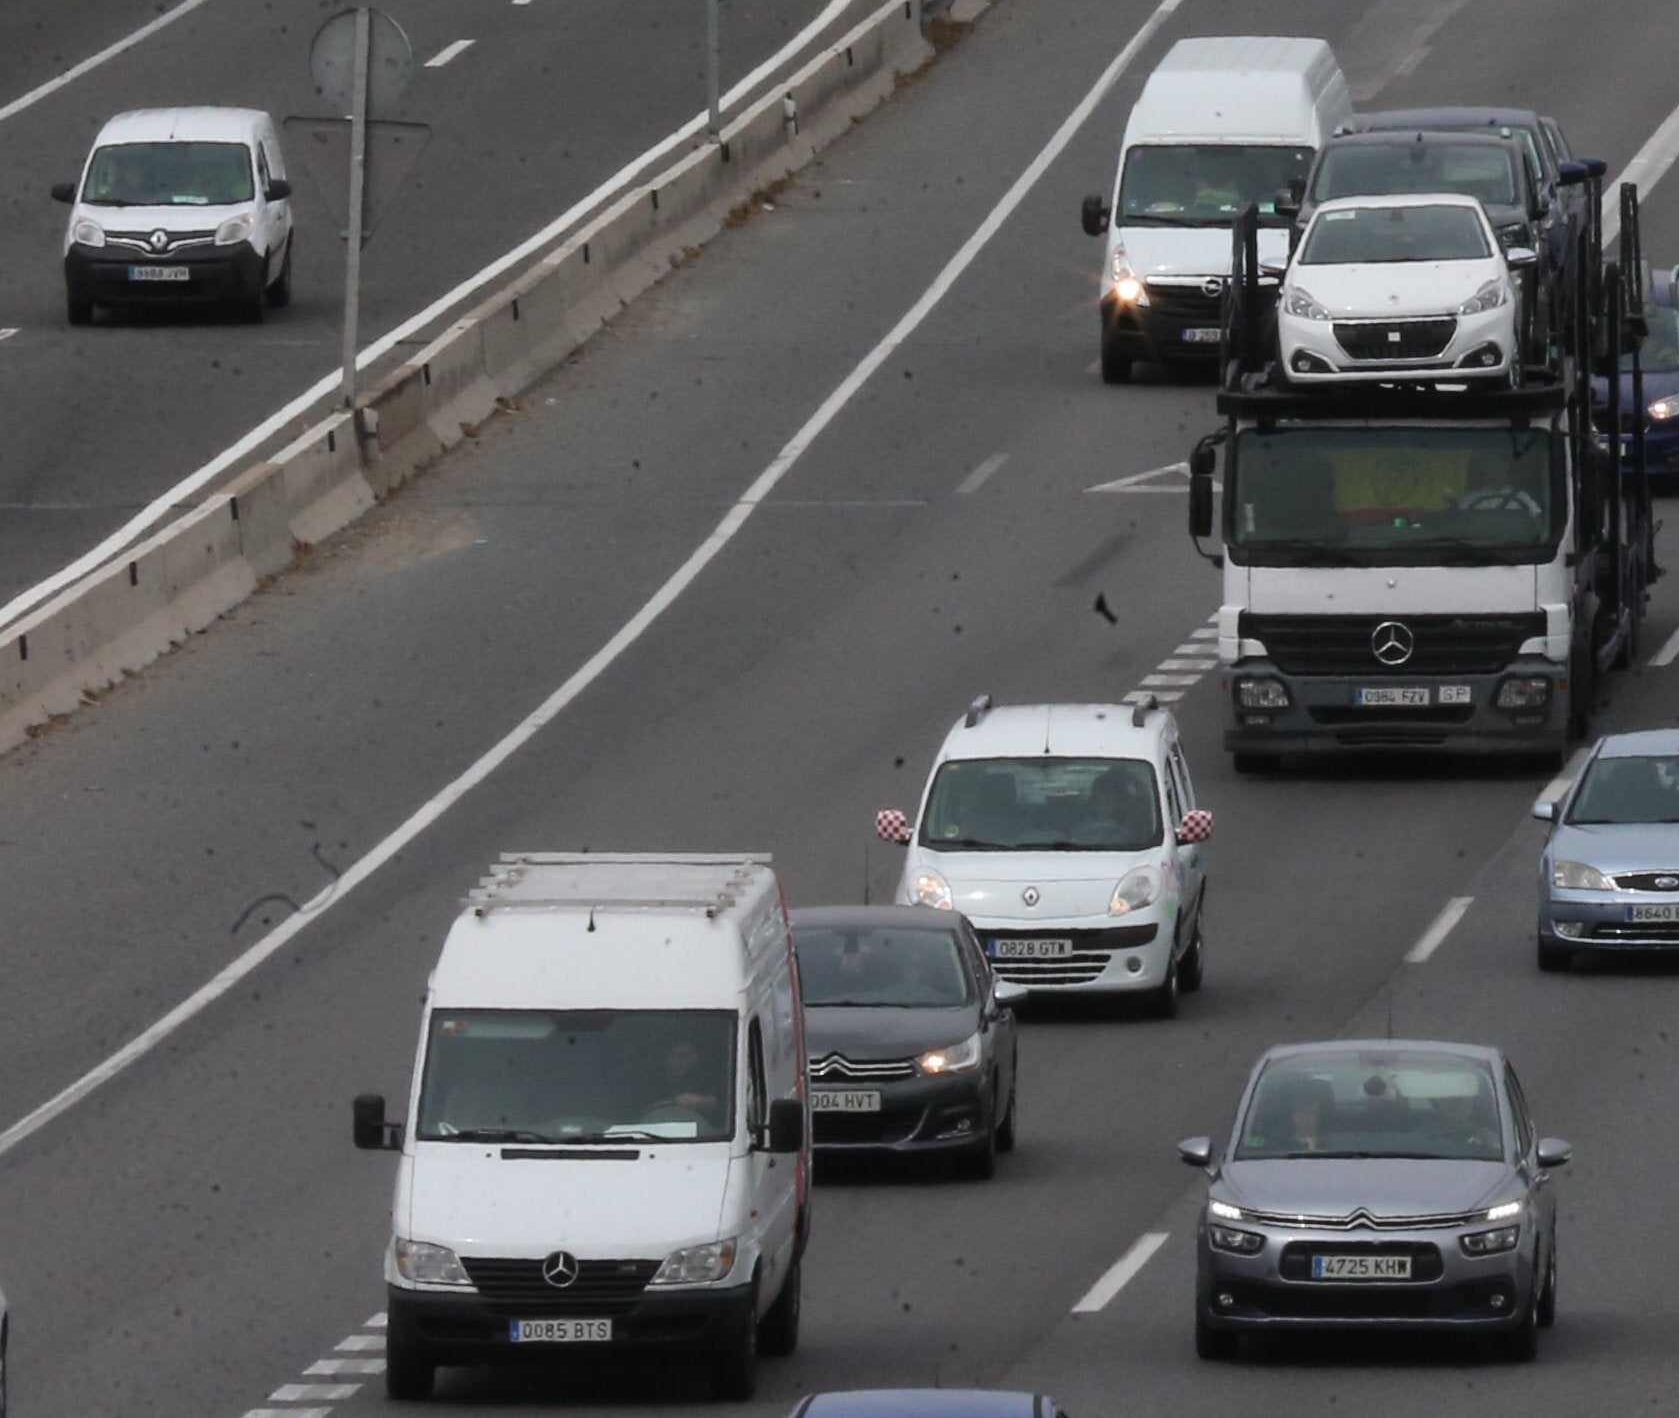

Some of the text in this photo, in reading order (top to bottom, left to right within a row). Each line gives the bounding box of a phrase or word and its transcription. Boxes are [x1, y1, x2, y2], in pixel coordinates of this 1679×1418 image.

[1402, 689, 1425, 703] FZV
[1634, 906, 1672, 920] 8640
[999, 942, 1066, 957] 0828 GTW
[844, 1093, 874, 1109] HVT
[1324, 1258, 1408, 1276] 4725 KHW
[522, 1322, 609, 1340] 0085 BTS
